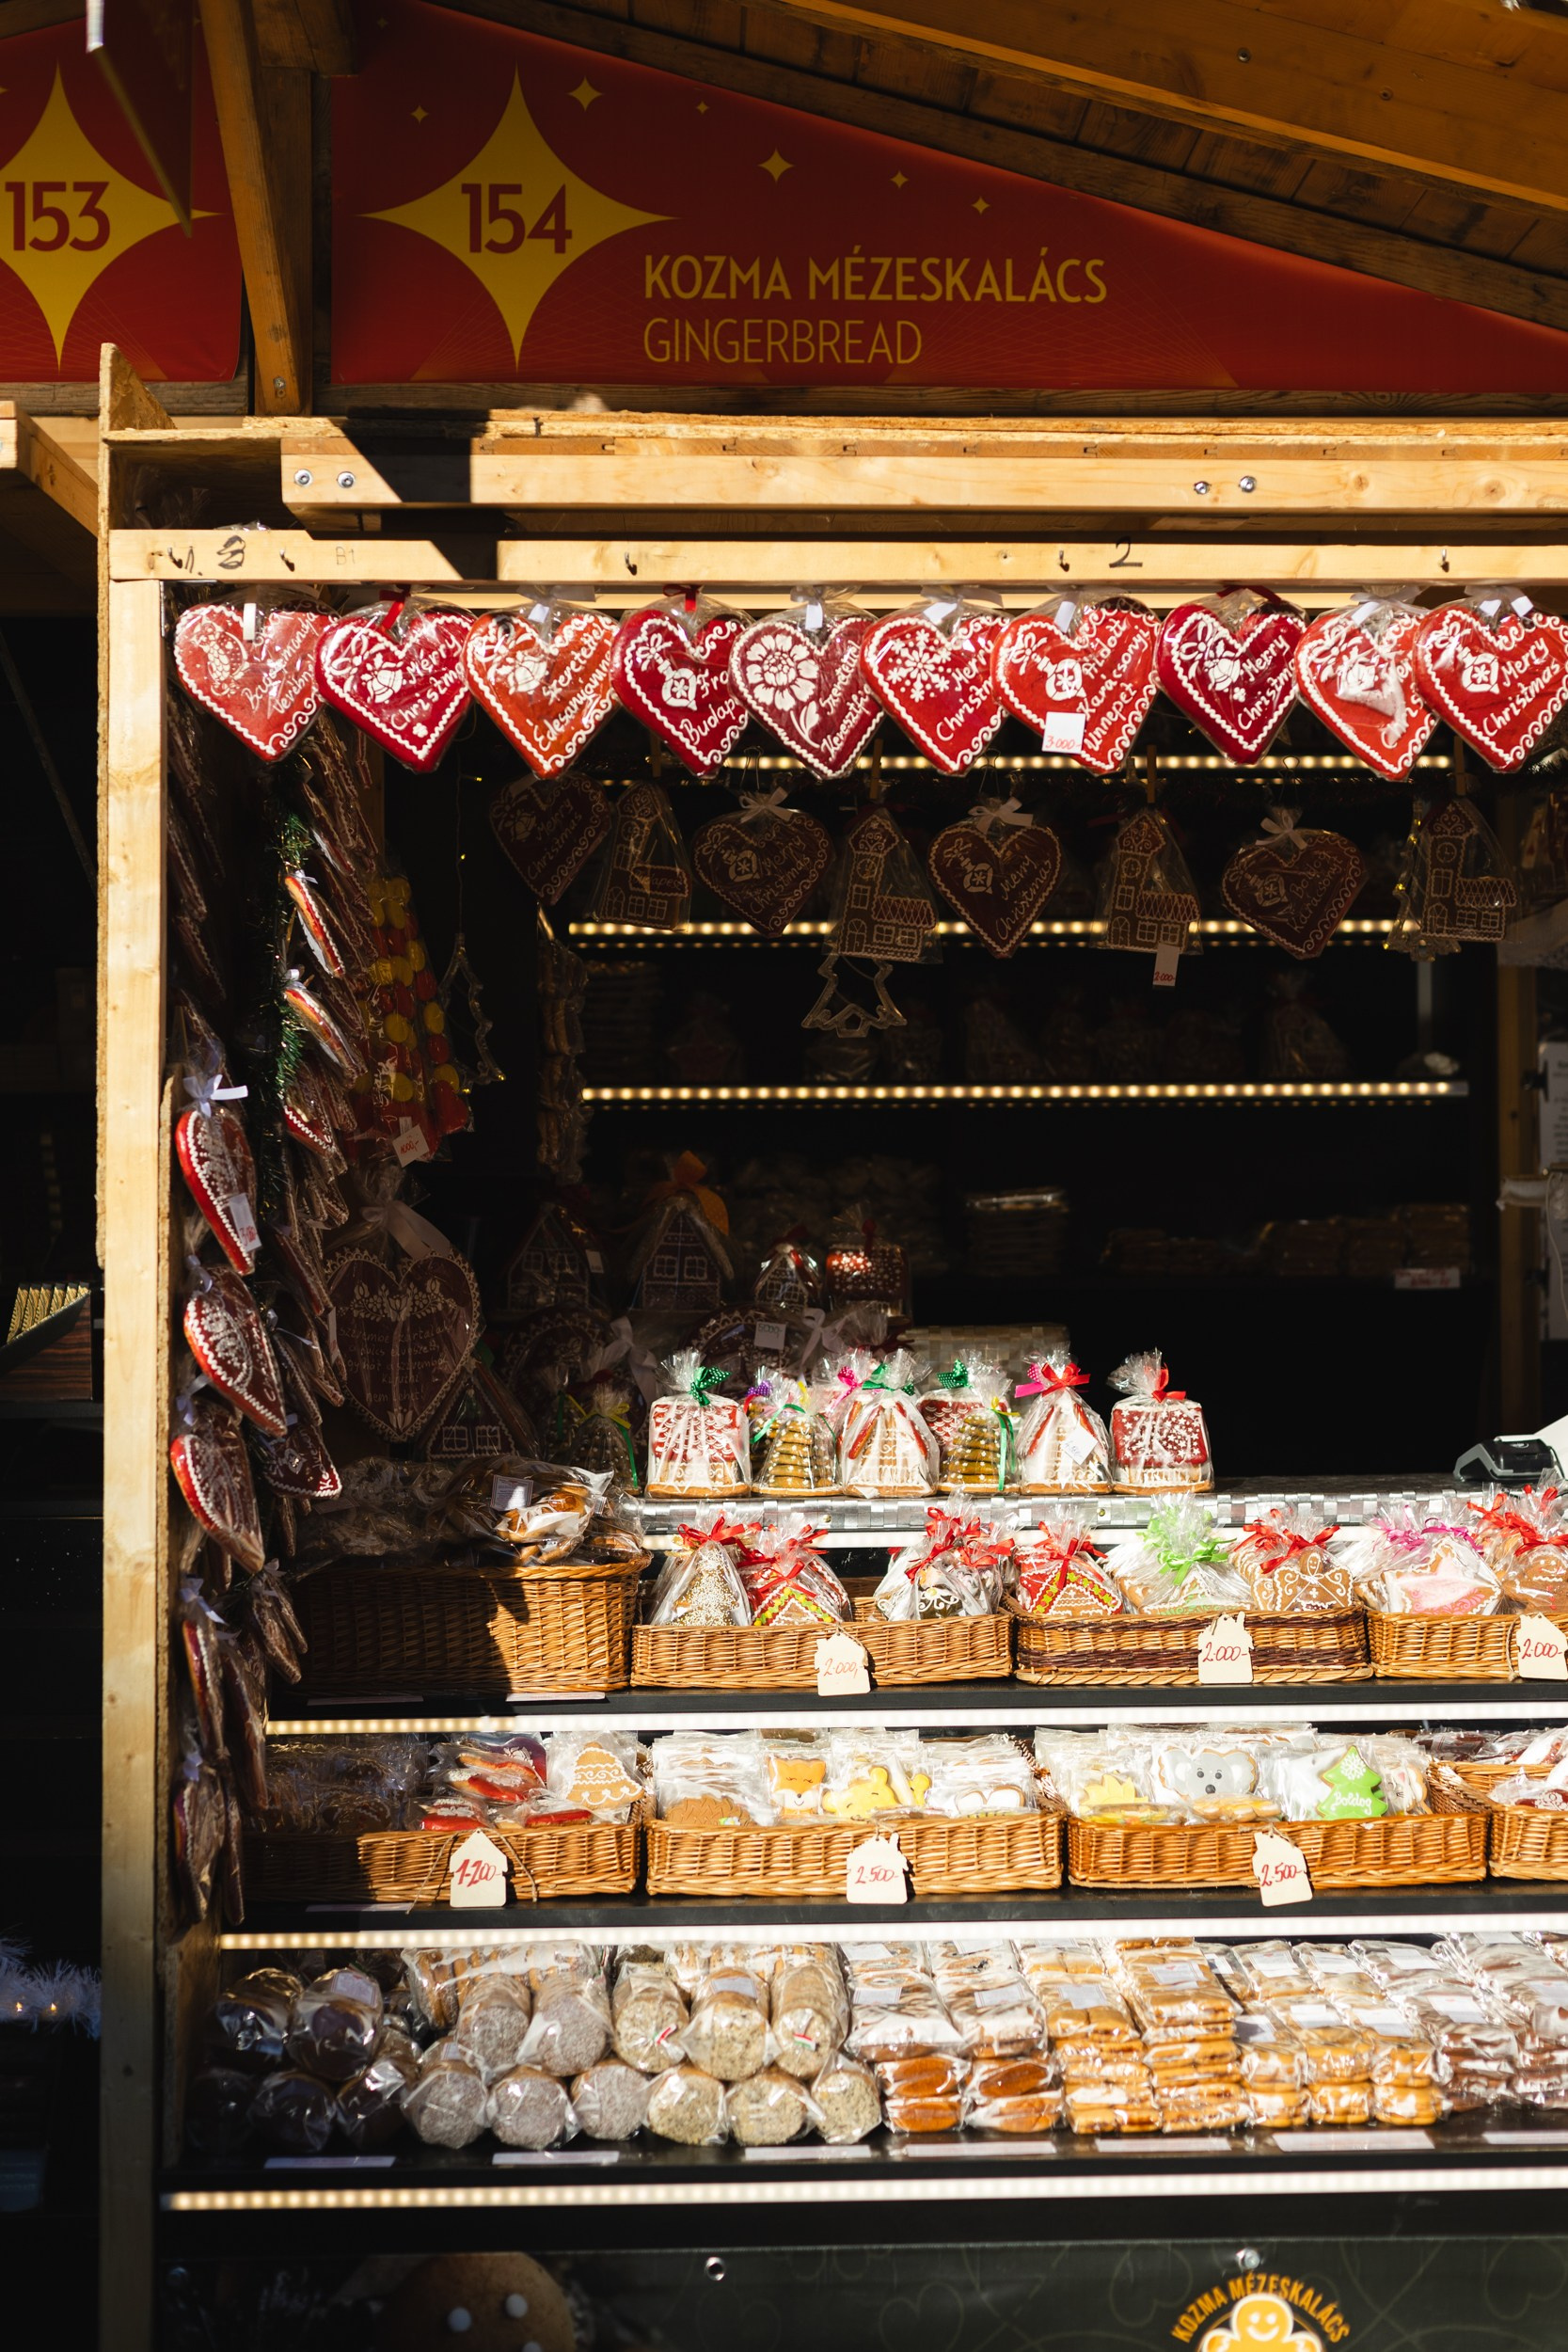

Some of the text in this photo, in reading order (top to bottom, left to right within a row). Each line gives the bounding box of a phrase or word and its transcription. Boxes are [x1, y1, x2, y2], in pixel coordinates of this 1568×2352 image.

[5, 182, 110, 251] 153
[461, 183, 573, 254] 154
[643, 245, 1108, 304] KOZMA MÉZESKALÁCS
[643, 317, 923, 364] GINGERBREAD
[696, 668, 730, 699] Fro
[1242, 635, 1291, 683] Merry
[1500, 637, 1550, 688] Merry
[390, 661, 466, 731] Christma
[526, 639, 611, 752] Édesanyámna
[679, 698, 736, 746] Budap
[936, 676, 994, 742] Christm
[1237, 658, 1295, 731] Christma
[1482, 658, 1561, 737] Christmas
[526, 811, 583, 881] Christmas
[535, 798, 575, 842] Merry
[750, 853, 812, 914] Christmas
[995, 859, 1053, 941] Christmas
[1000, 854, 1037, 901] Merry
[1330, 1791, 1372, 1816] Boldog
[1171, 2270, 1351, 2344] KOZMA MÉZESKALÁCS
